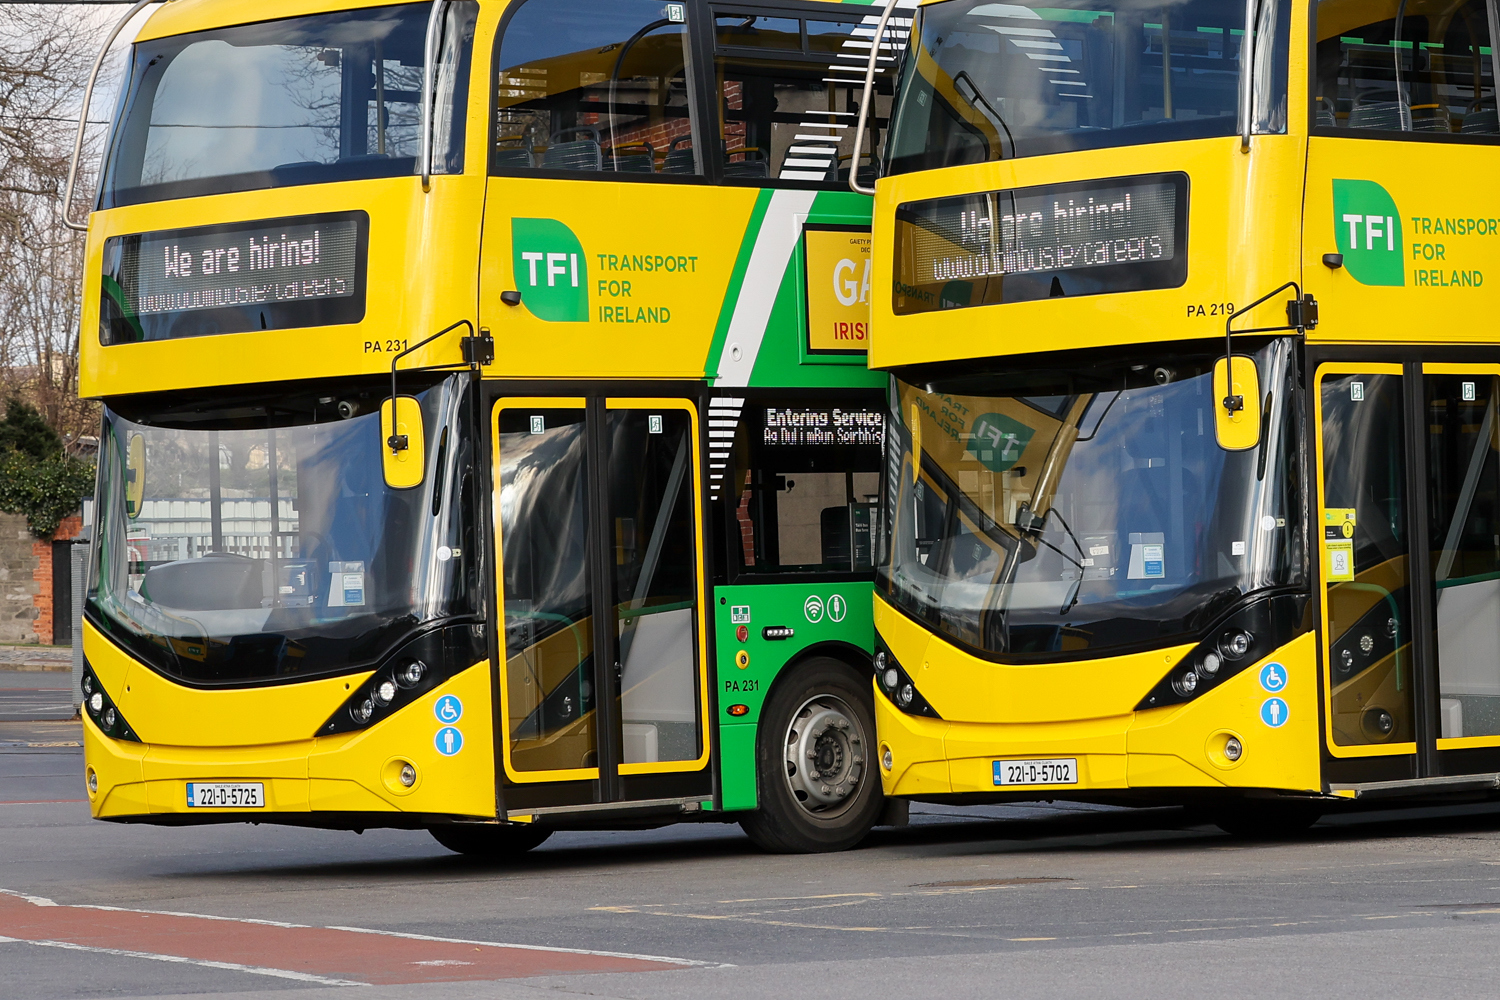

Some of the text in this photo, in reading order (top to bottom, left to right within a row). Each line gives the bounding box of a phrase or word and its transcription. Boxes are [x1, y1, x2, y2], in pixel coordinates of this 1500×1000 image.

[1002, 211, 1043, 240] are
[1342, 214, 1394, 251] TFI
[164, 230, 320, 278] We are hiring!
[933, 235, 1162, 280] www.dublinbus.ie/careers
[1412, 244, 1446, 261] FOR
[522, 252, 579, 288] TFI
[597, 254, 698, 272] TRANSPORT
[1414, 270, 1484, 288] IRELAND
[598, 280, 632, 298] FOR
[598, 306, 671, 324] IRELAND
[1186, 303, 1234, 318] PA 219
[364, 339, 408, 354] PA 231
[766, 408, 882, 426] Entering Service
[764, 428, 778, 445] Ag
[725, 680, 760, 692] PA 231
[1008, 764, 1070, 782] 221-D-5702
[200, 788, 257, 805] 221-D-5725
